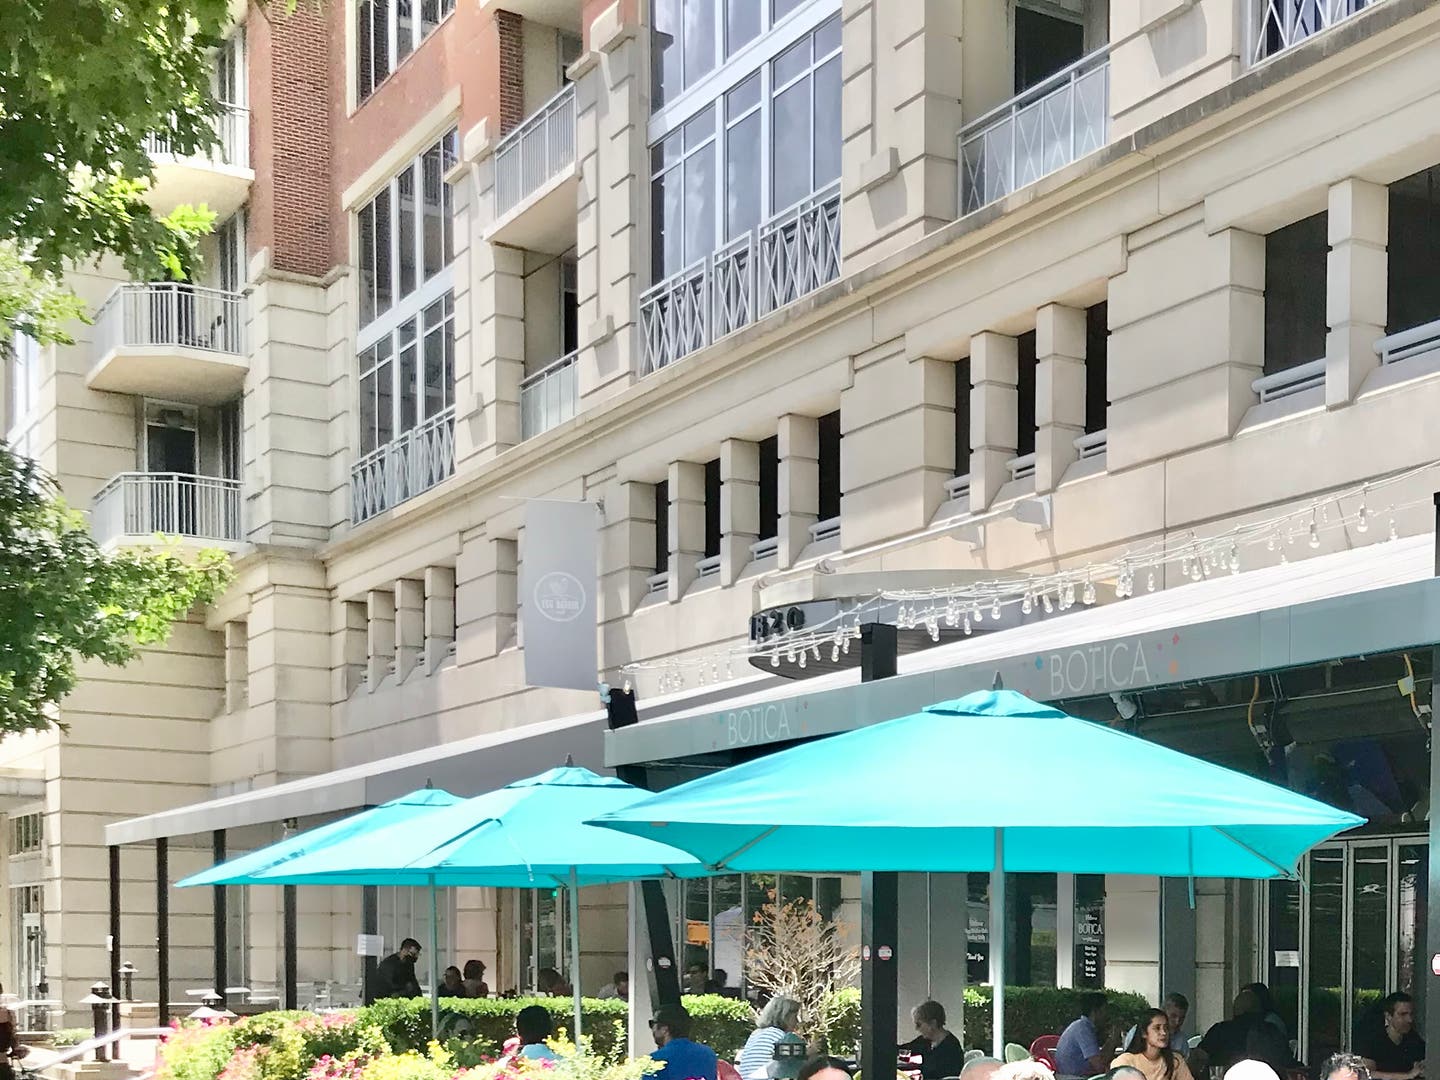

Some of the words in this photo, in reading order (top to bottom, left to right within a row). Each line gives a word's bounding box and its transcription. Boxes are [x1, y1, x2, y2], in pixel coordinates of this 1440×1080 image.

[1050, 639, 1150, 696] BOTICA
[728, 703, 791, 746] BOTICA
[1078, 923, 1103, 934] BOTICA
